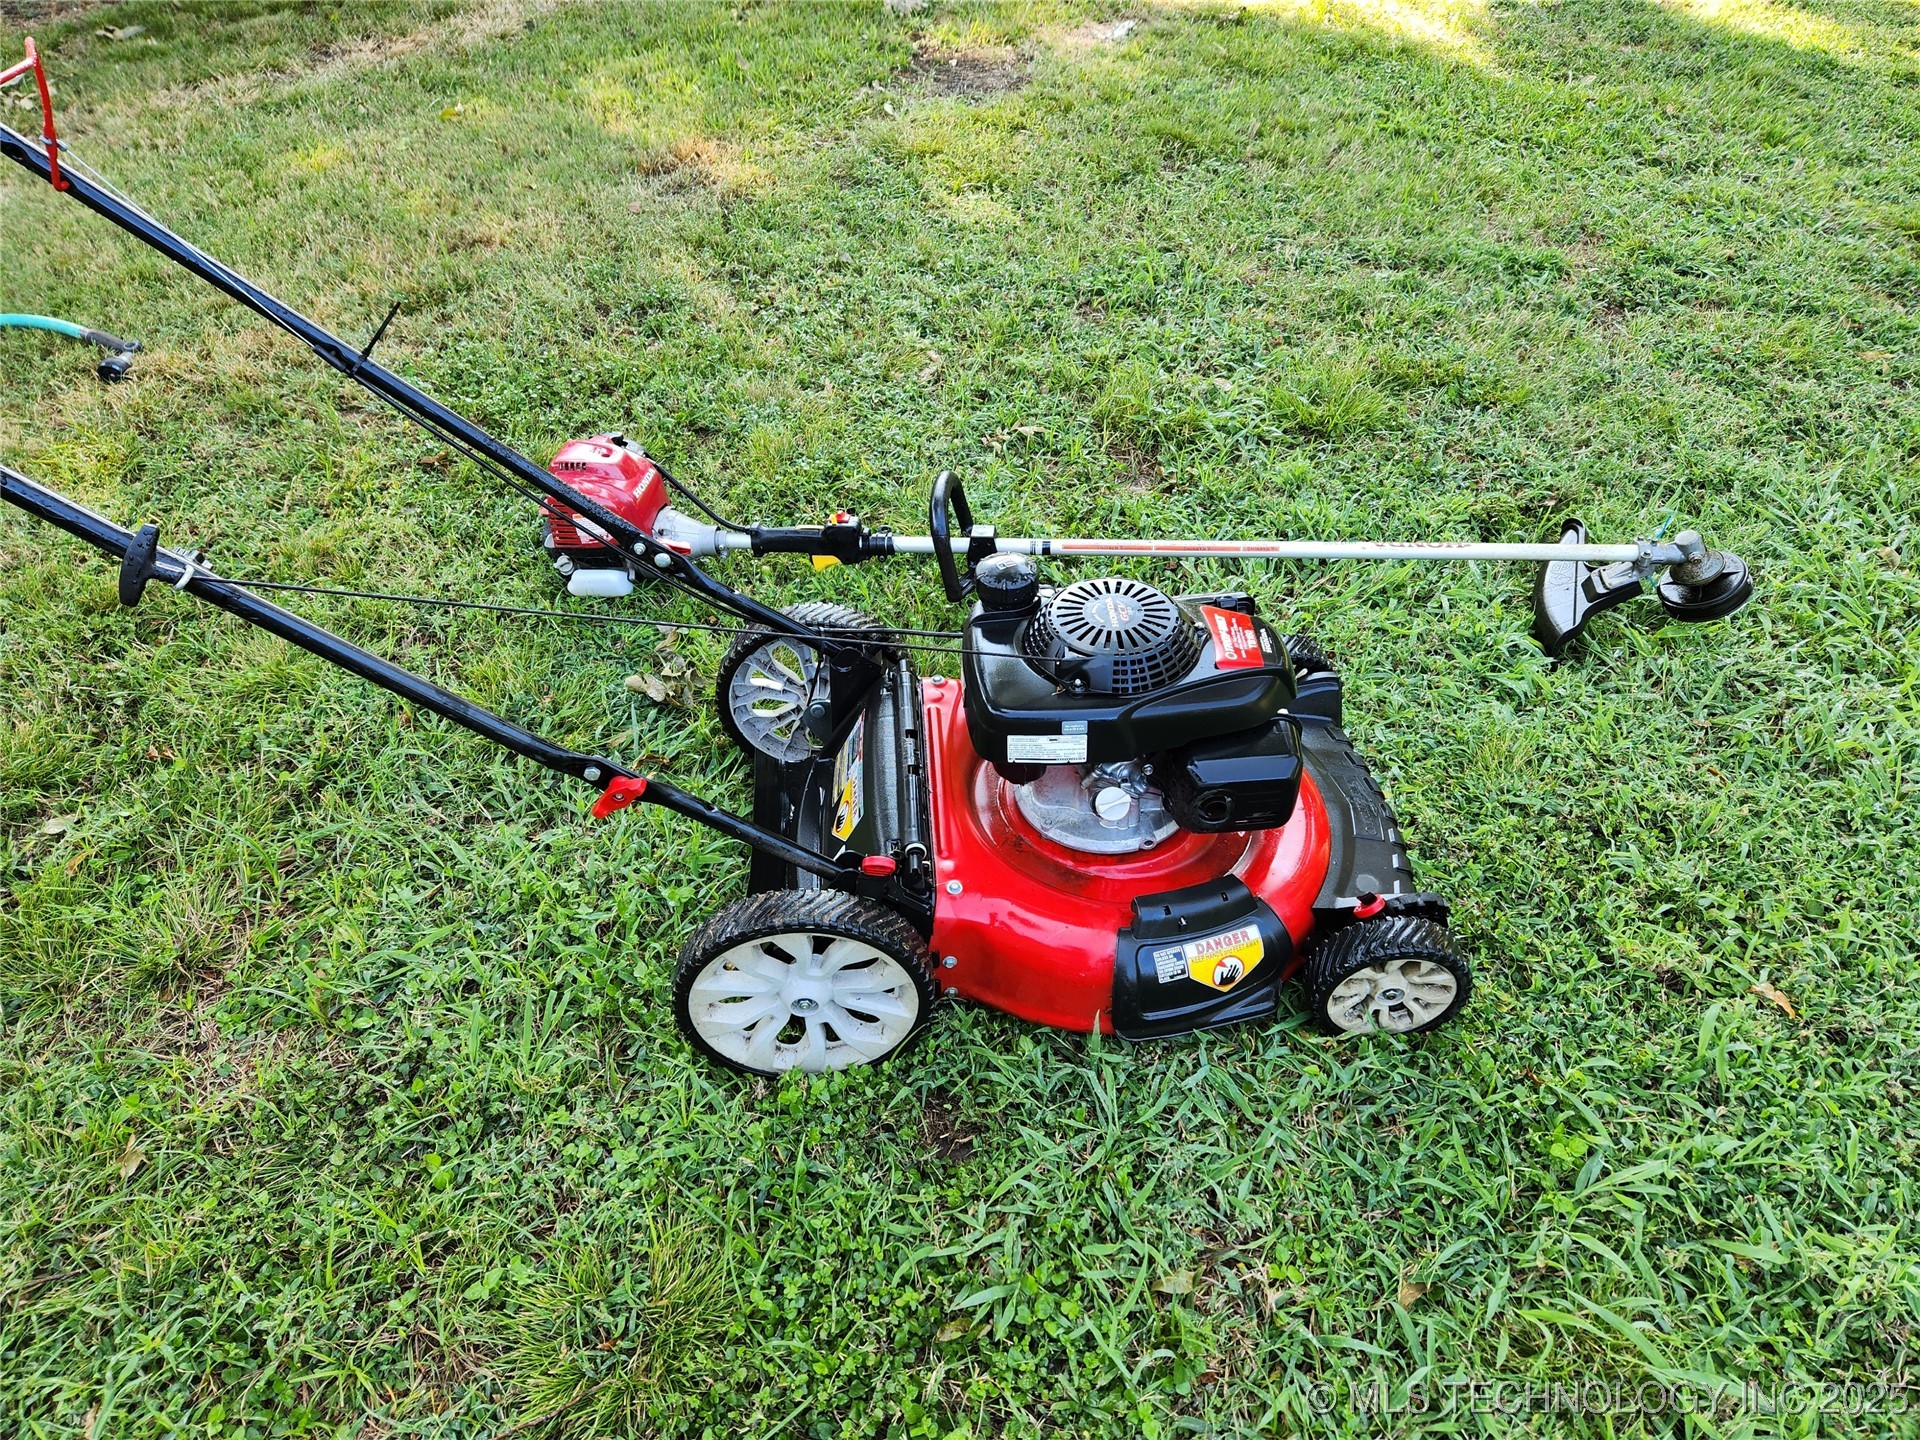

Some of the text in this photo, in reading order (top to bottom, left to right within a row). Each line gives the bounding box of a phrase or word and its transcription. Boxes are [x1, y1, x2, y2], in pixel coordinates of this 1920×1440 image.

[633, 467, 656, 499] HONDA
[1105, 597, 1120, 627] HONDA
[1191, 955, 1205, 964] KEEP
[1205, 950, 1223, 960] HANDS
[1233, 945, 1245, 953] FEET
[1245, 940, 1260, 948] AWAY
[1195, 930, 1251, 955] DANGER
